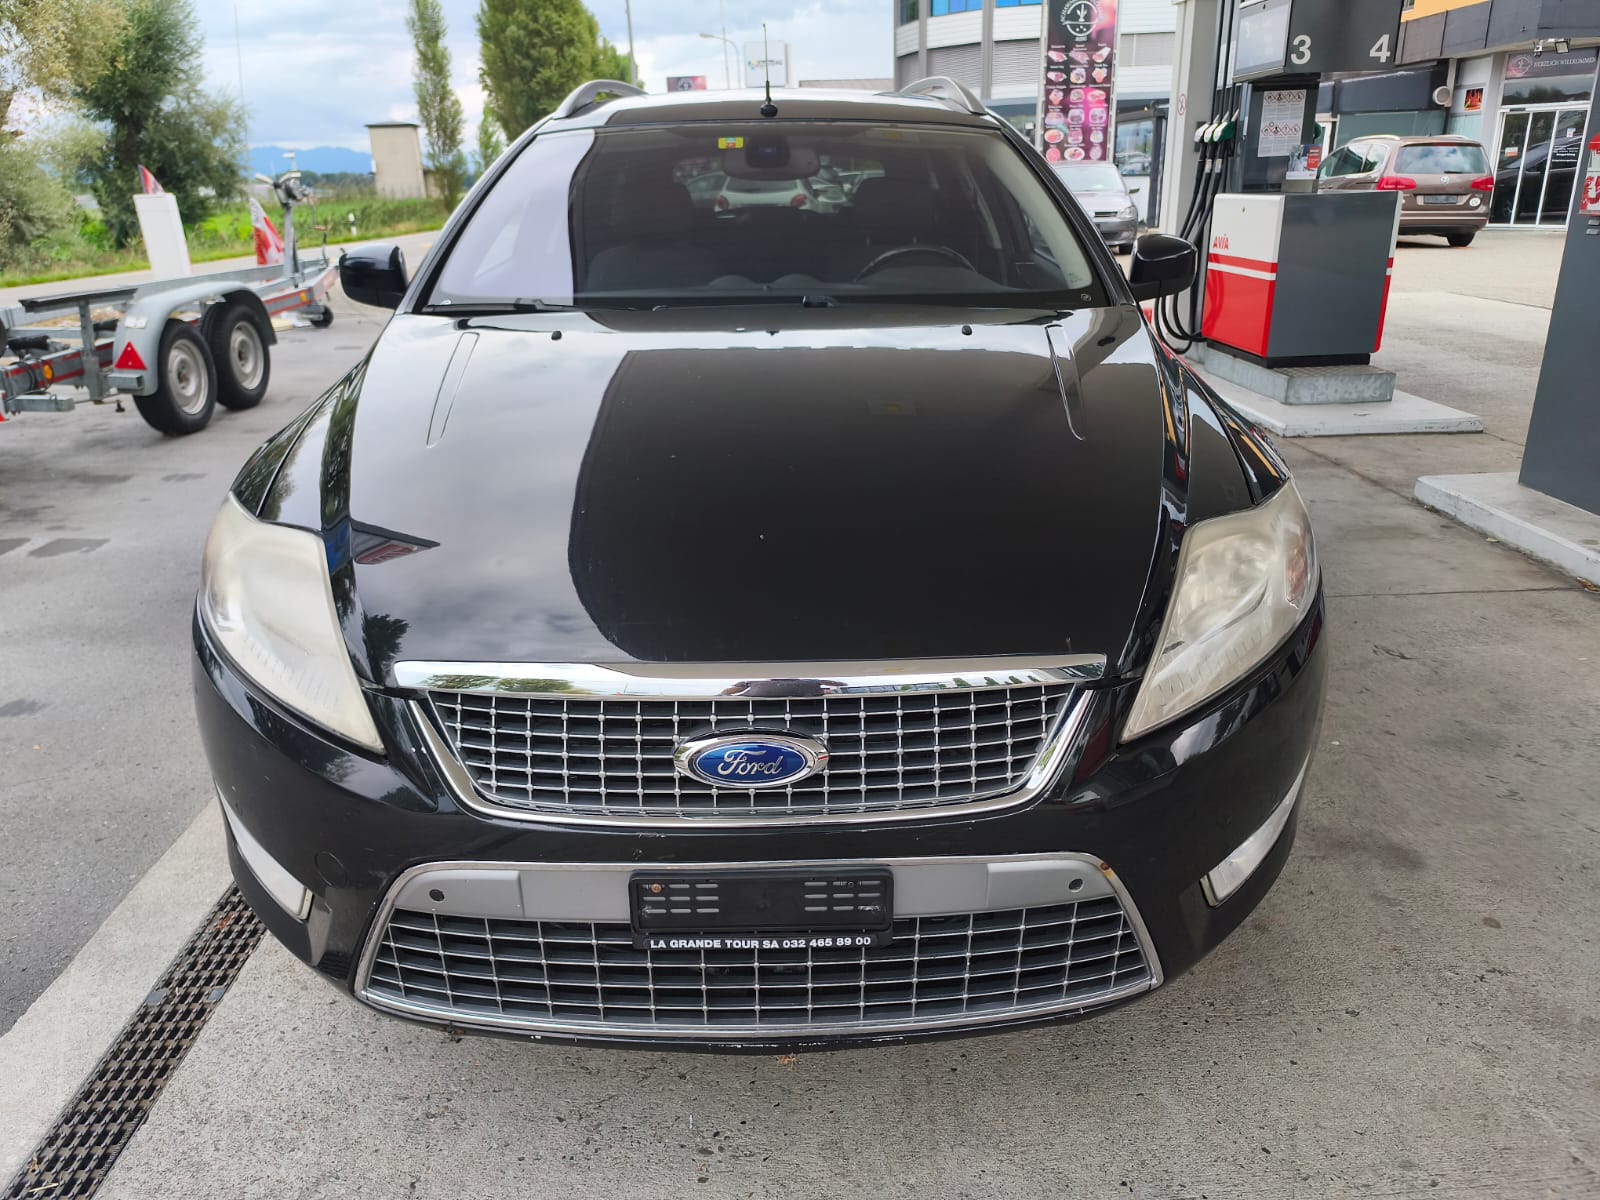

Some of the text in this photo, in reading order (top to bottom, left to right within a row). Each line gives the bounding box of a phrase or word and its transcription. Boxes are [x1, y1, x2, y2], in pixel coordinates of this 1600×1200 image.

[1290, 34, 1312, 65] 3
[1369, 34, 1391, 63] 4
[717, 750, 784, 775] Ford
[650, 936, 872, 949] LA GRANDE TOUR SA 032 465 89 00
